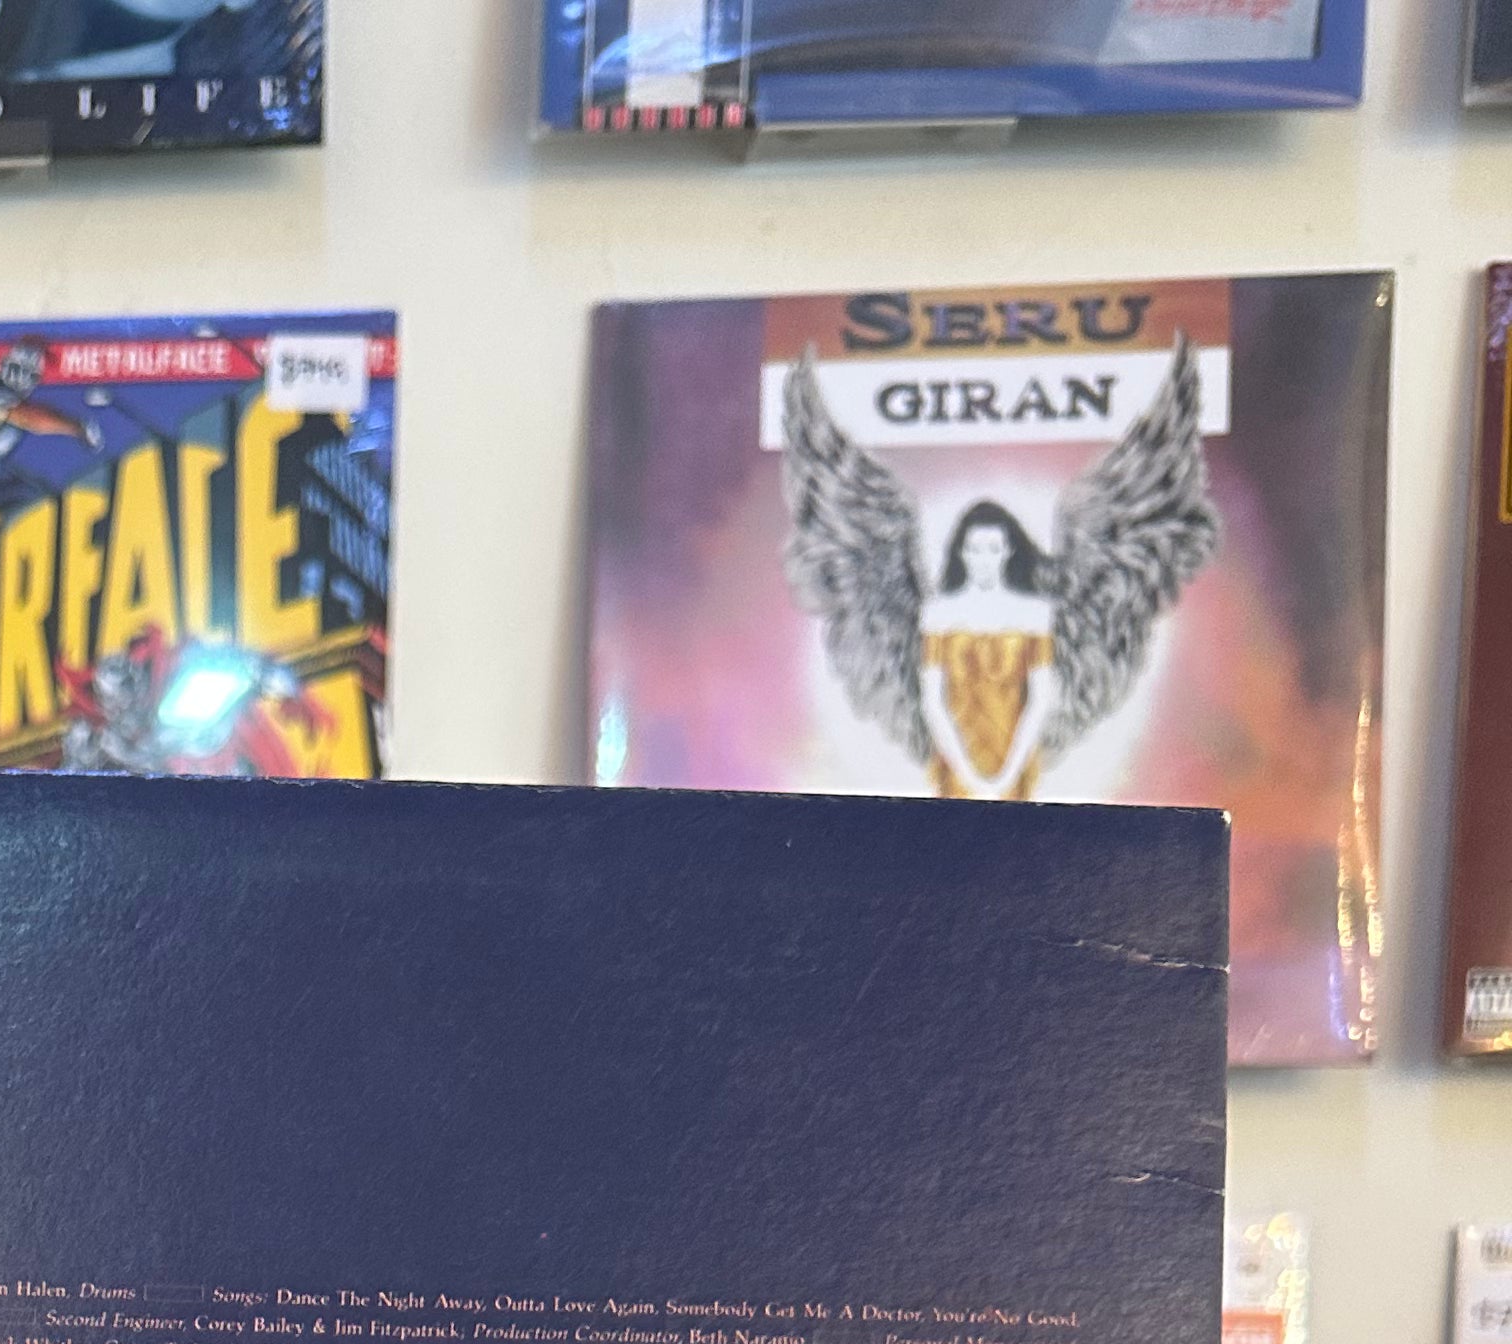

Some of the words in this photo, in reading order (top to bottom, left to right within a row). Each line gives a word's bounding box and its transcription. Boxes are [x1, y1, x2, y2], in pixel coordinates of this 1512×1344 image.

[78, 77, 290, 119] LIFE
[874, 373, 1120, 424] GIRAN
[45, 1310, 107, 1328] Second
[112, 1312, 187, 1334] Engineer,
[193, 1314, 246, 1336] Corey
[253, 1316, 305, 1337] Bailey
[334, 1318, 363, 1335] Jim
[473, 1322, 569, 1341] Production
[78, 1282, 137, 1300] Drums
[276, 1289, 330, 1307] Dance
[336, 1290, 371, 1308] The
[377, 1292, 426, 1313] Night
[434, 1293, 487, 1315] Away,
[493, 1295, 546, 1314] Outta
[553, 1297, 597, 1315] Love
[602, 1299, 659, 1320] Again,
[665, 1300, 757, 1322] Somebody
[764, 1302, 796, 1319] Get
[861, 1305, 925, 1326] Doctor,
